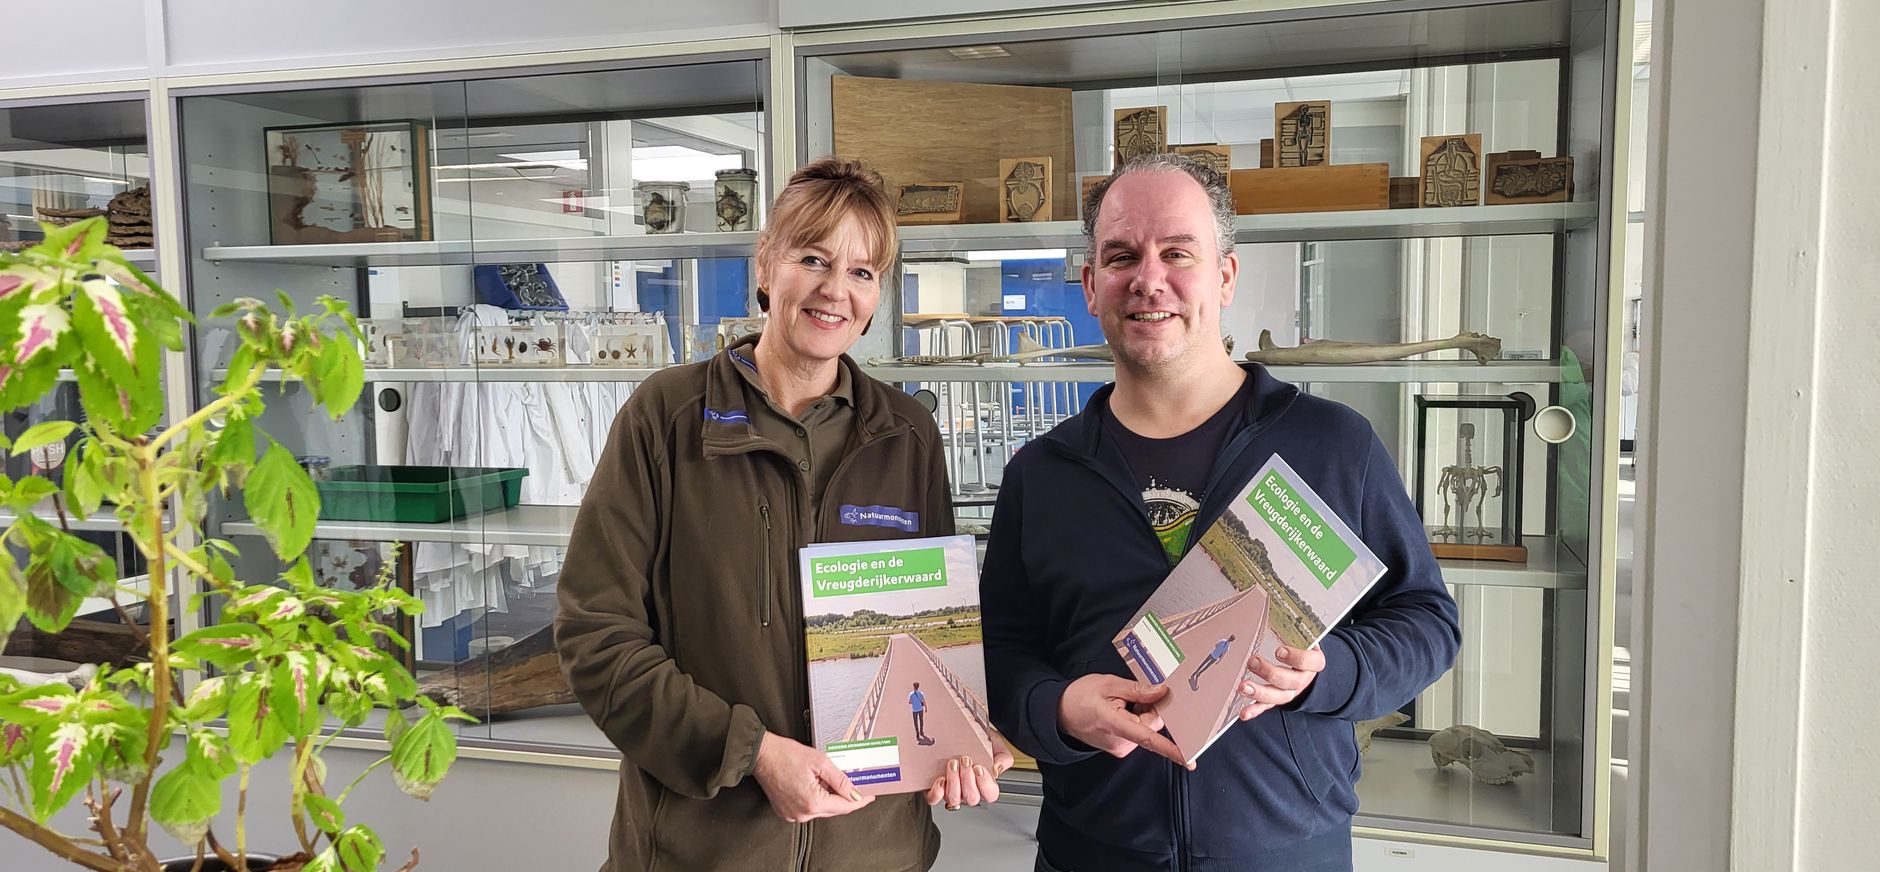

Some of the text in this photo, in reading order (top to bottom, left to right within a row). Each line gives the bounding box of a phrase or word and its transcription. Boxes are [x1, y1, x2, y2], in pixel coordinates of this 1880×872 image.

[1265, 475, 1324, 540] Ecologie en de
[1254, 489, 1338, 581] Vreugderijkerwaard
[815, 556, 904, 574] Ecologie en de
[816, 569, 942, 592] Vreugderijkerwaard
[849, 771, 897, 782] tuurmonumenten
